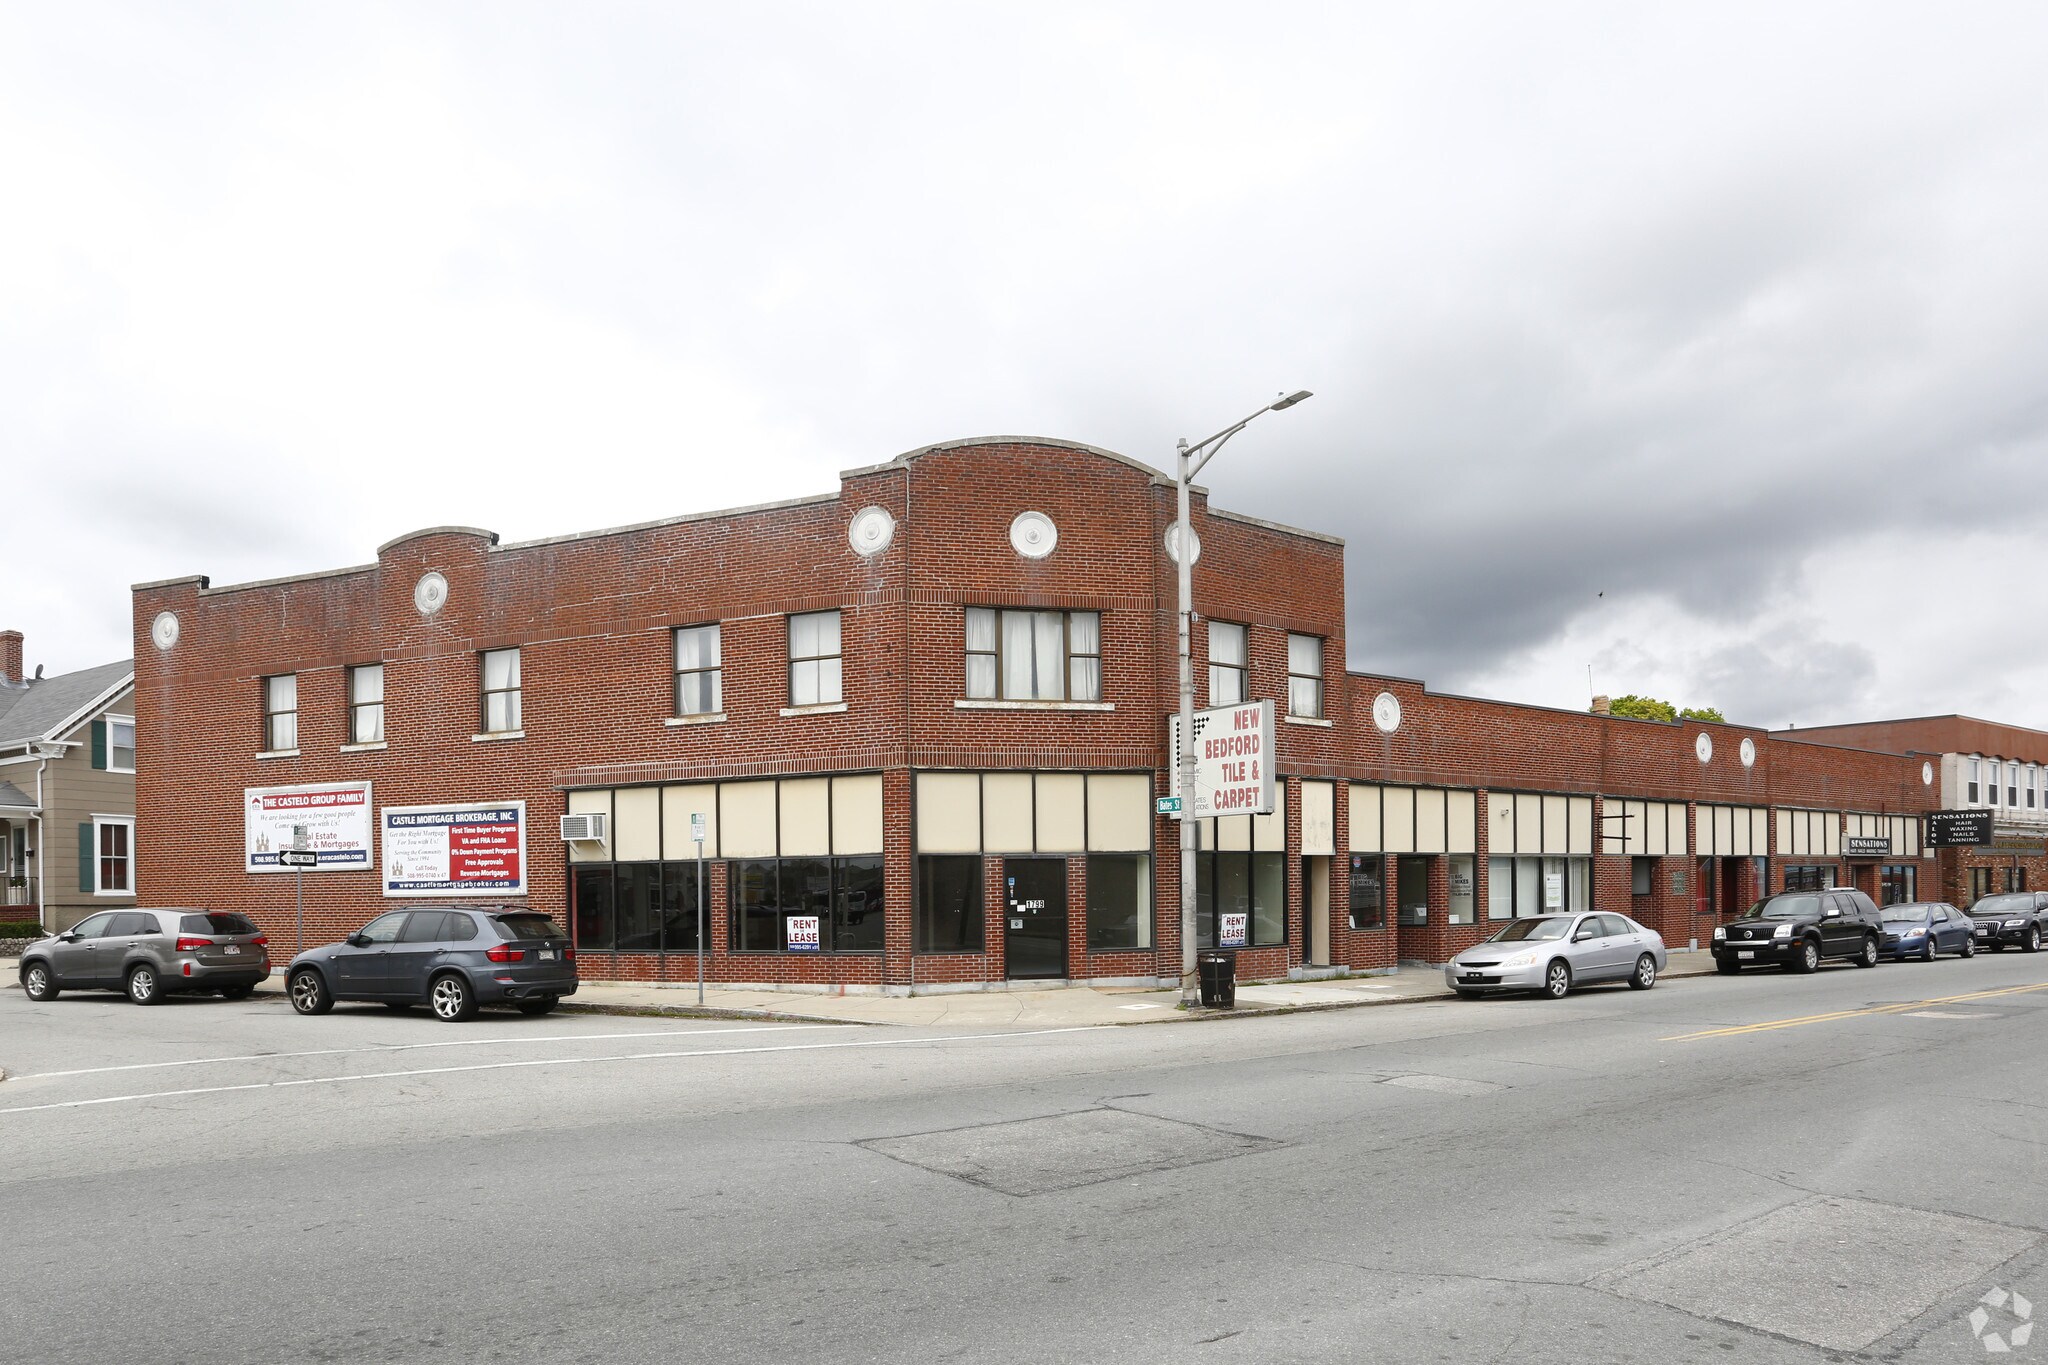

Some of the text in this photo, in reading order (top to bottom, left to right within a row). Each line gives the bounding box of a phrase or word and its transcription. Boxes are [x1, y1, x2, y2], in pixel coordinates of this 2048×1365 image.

[1234, 708, 1260, 730] NEW
[1205, 734, 1260, 759] BEDFORD
[1222, 760, 1260, 783] TILE &
[264, 793, 364, 807] THE CASTELO GROUP FAMILY
[1214, 787, 1260, 810] CARPET
[1160, 800, 1180, 810] Bates St
[278, 813, 298, 821] looking
[299, 812, 307, 820] for
[313, 811, 323, 819] few
[323, 811, 337, 819] good
[337, 810, 356, 819] people
[391, 811, 515, 826] CASTLE MORTGAGE BROKERAGE, INC.
[1931, 812, 1988, 820] SENSATIONS
[407, 830, 422, 838] Right
[422, 829, 447, 837] Mortgage
[463, 826, 476, 834] Time
[476, 826, 492, 835] Buyer
[491, 825, 517, 834] Programs
[315, 831, 338, 840] Estate
[313, 841, 319, 849] &
[320, 840, 360, 849] Mortgages
[461, 837, 469, 845] VA
[469, 837, 480, 845] and
[491, 836, 507, 844] Loans
[1851, 839, 1888, 848] SENSATIONS
[473, 847, 494, 856] Payment
[494, 847, 518, 855] Programs
[465, 857, 504, 867] Free Approvals
[480, 869, 509, 878] Mortgages
[399, 881, 510, 889] www.castlemortgagebroker.com
[793, 920, 817, 929] RENT
[1227, 917, 1245, 925] RENT
[789, 933, 818, 942] LEASE
[1222, 929, 1244, 938] LEASE
